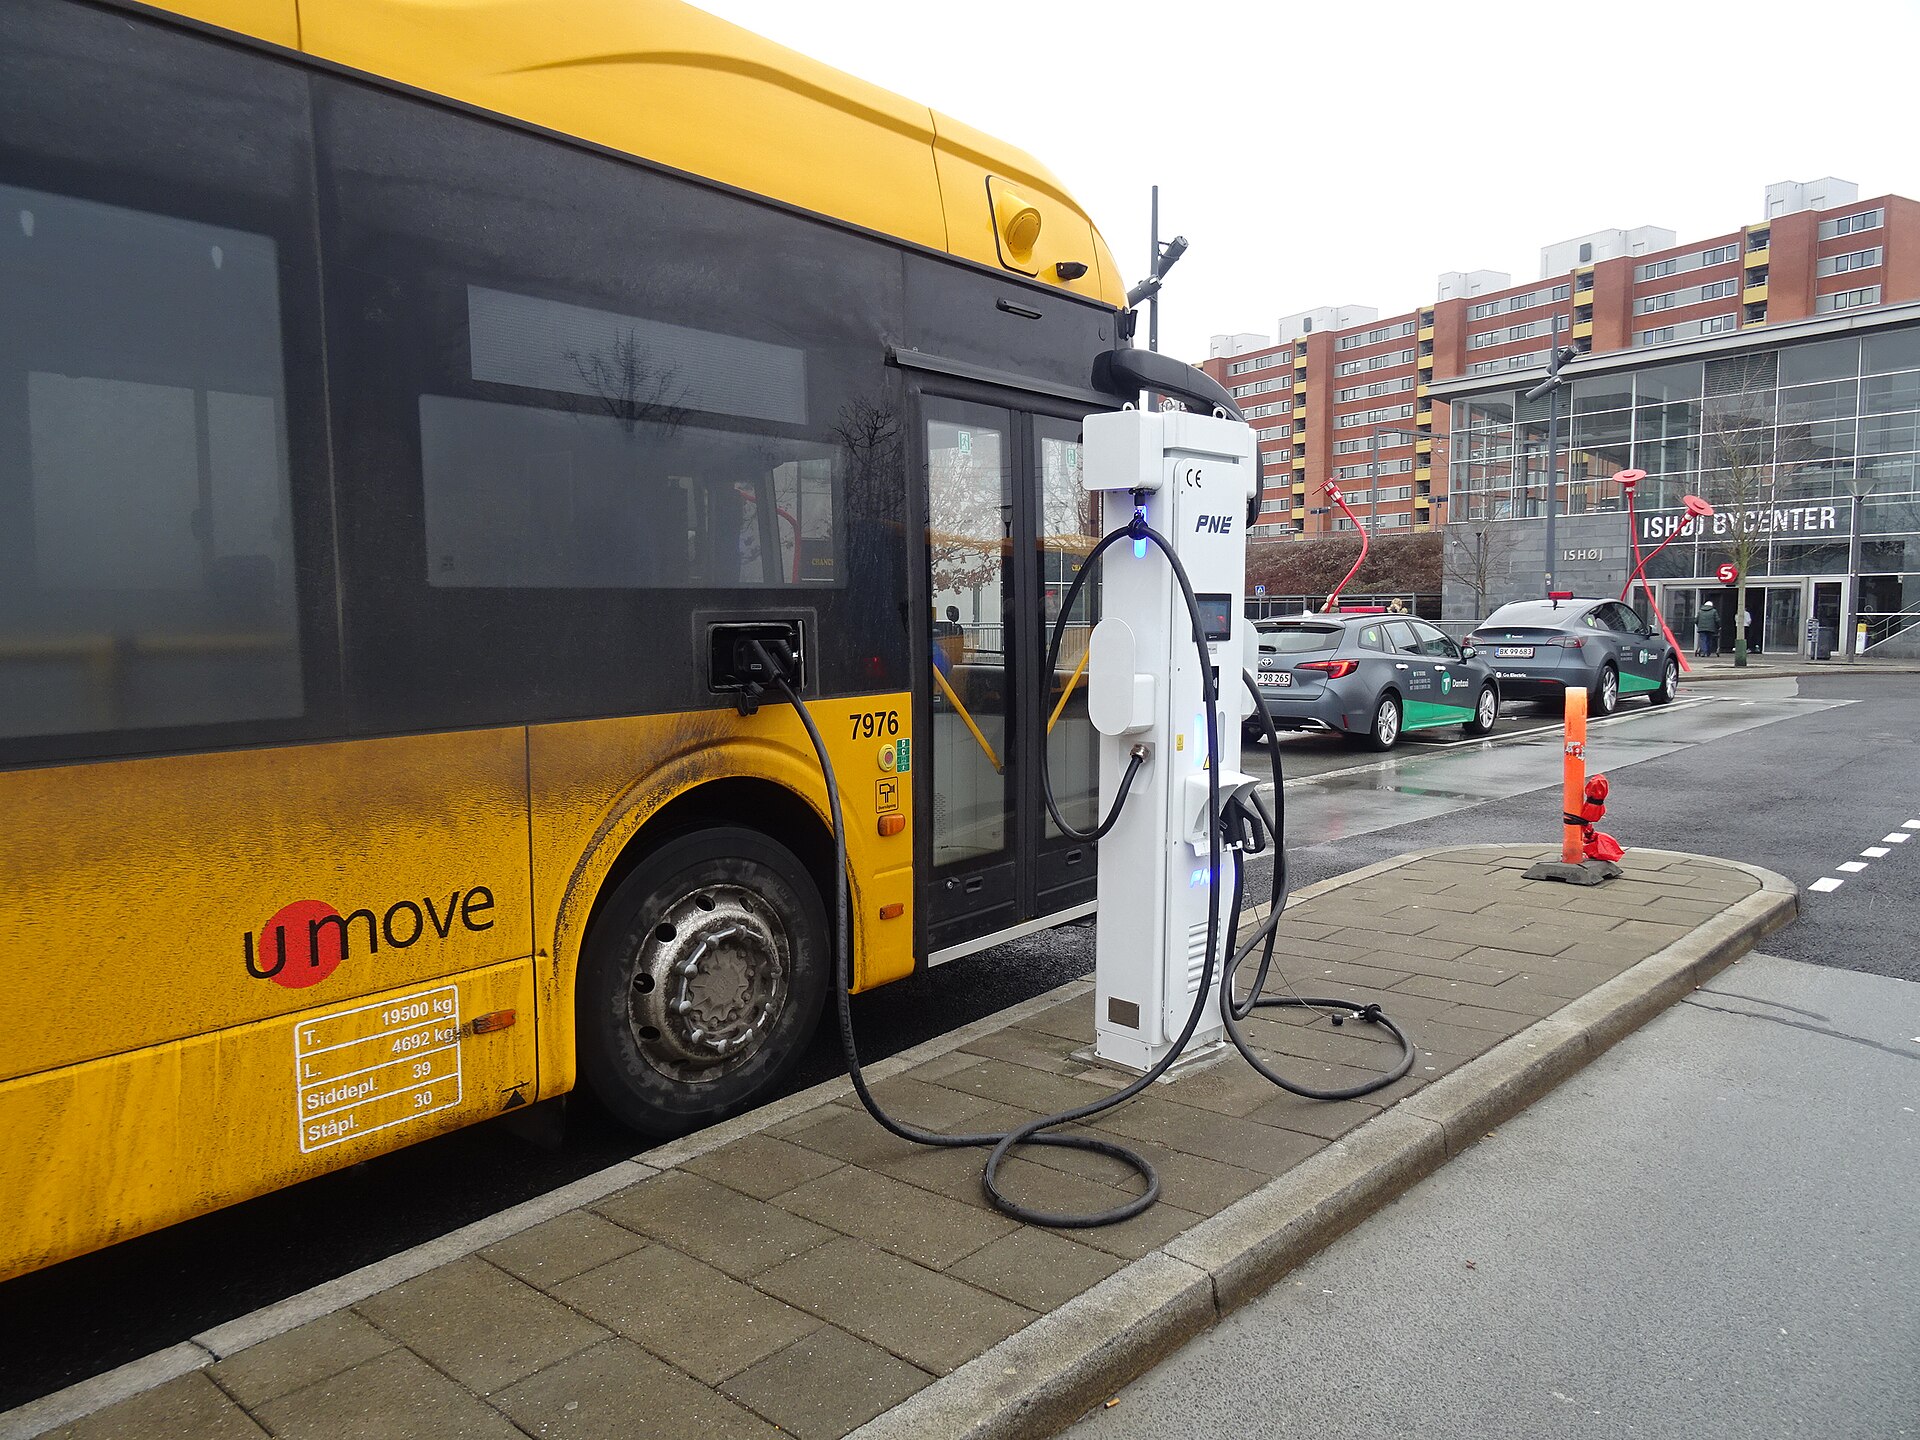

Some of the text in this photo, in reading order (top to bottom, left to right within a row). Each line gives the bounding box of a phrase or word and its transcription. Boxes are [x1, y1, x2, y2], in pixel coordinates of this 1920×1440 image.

[1186, 468, 1202, 488] CE
[1195, 514, 1233, 534] PNE
[1713, 506, 1836, 535] BYCENTER
[1563, 548, 1603, 562] ISHØJ
[1719, 566, 1733, 580] S
[1263, 673, 1273, 682] 98
[1274, 674, 1289, 683] 265
[849, 710, 899, 740] 7976
[303, 998, 453, 1046] T. 19500 kg
[304, 1063, 322, 1079] L.
[391, 1031, 430, 1054] 4692
[306, 1061, 432, 1110] Siddepl. 39
[308, 1090, 433, 1141] Ståpl. 30
